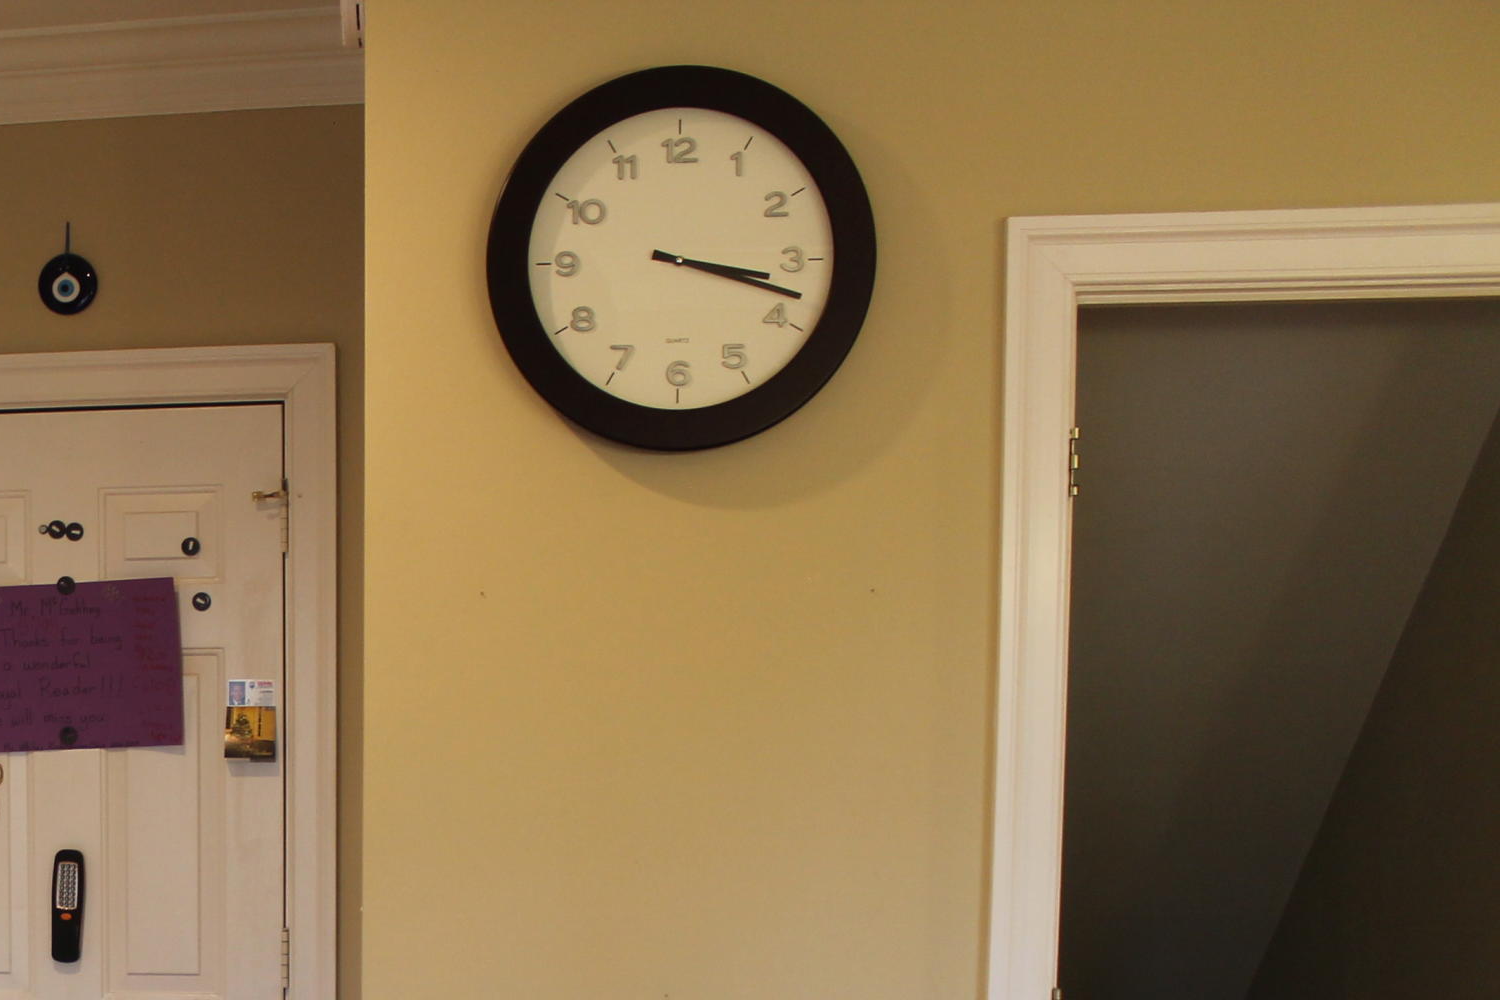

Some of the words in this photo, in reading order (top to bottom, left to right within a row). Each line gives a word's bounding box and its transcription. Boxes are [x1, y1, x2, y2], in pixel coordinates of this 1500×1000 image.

[661, 137, 698, 164] 12
[612, 154, 638, 180] 11
[730, 151, 743, 177] 1
[566, 198, 606, 225] 10
[763, 191, 789, 217] 2
[554, 251, 580, 277] 9
[780, 246, 804, 272] 3
[569, 306, 596, 332] 8
[762, 303, 787, 328] 4
[610, 344, 634, 370] 7
[722, 343, 747, 369] 5
[665, 360, 691, 386] 6
[60, 627, 81, 645] for
[90, 625, 124, 650] being
[3, 661, 12, 671] a
[22, 652, 91, 671] wonderful
[10, 709, 33, 727] will
